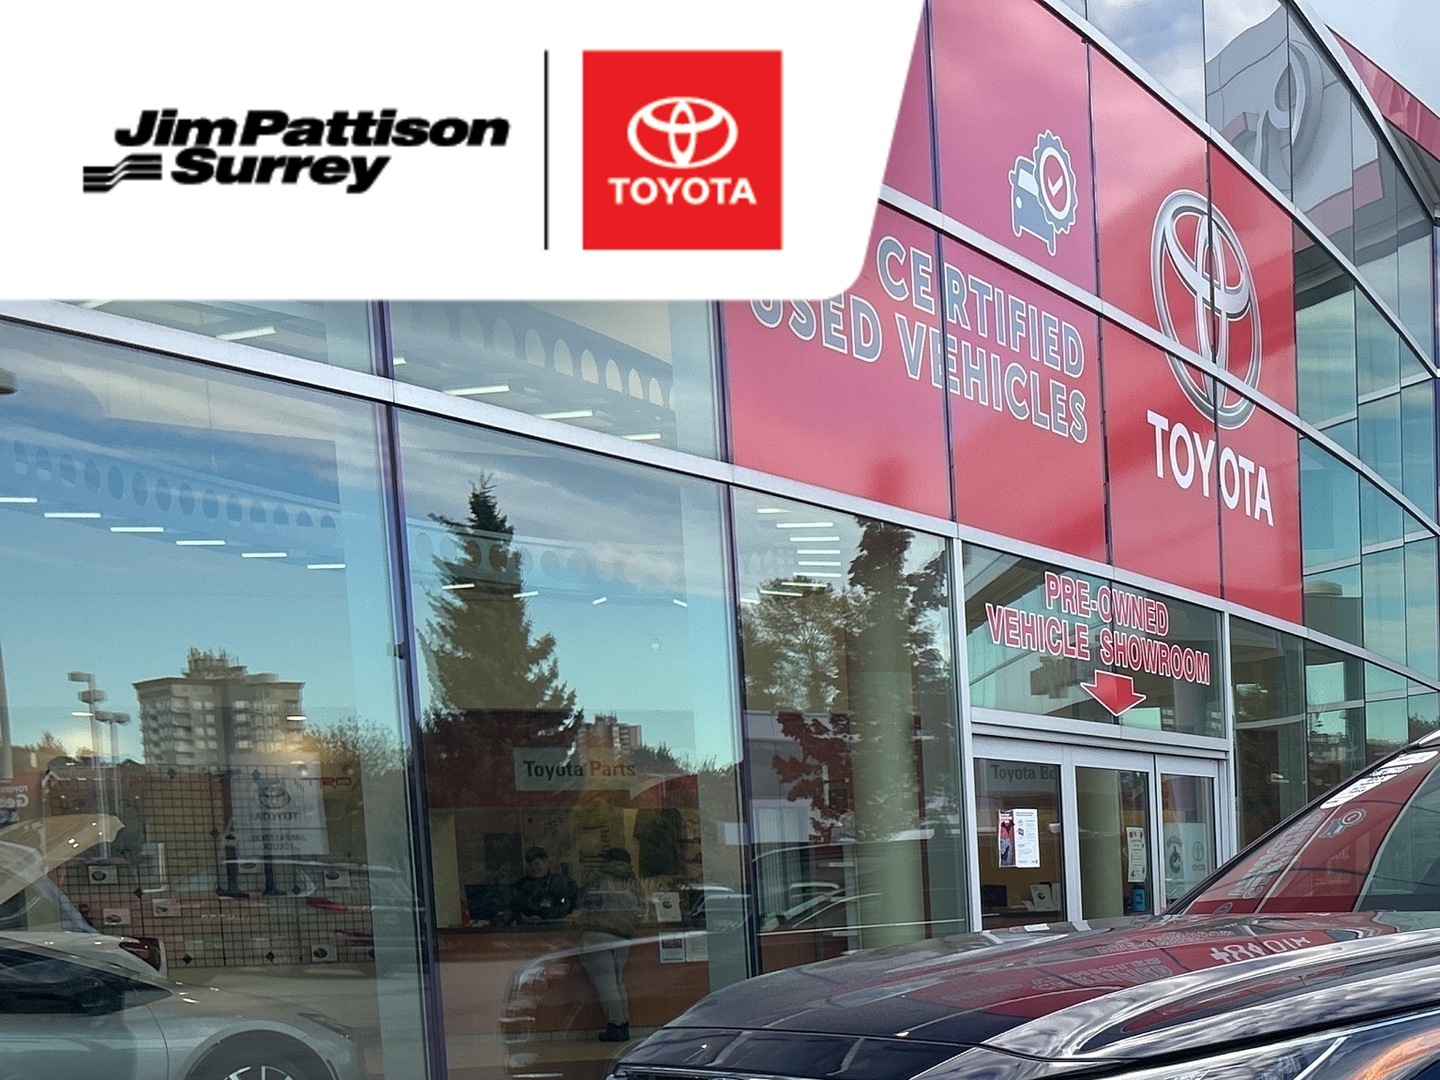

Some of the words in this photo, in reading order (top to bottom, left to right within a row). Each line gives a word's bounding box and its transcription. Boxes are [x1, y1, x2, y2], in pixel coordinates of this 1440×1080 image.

[877, 235, 1085, 379] CERTIFIED
[895, 312, 1088, 444] VEHICLES
[1146, 409, 1274, 527] TOYOTA
[985, 603, 1091, 662] VEHICLE
[1099, 627, 1211, 686] SHOWROOM
[1044, 571, 1170, 637] PRE-OWNED
[522, 760, 584, 781] Toyota
[589, 760, 636, 777] Parts
[990, 764, 1036, 784] Toyota
